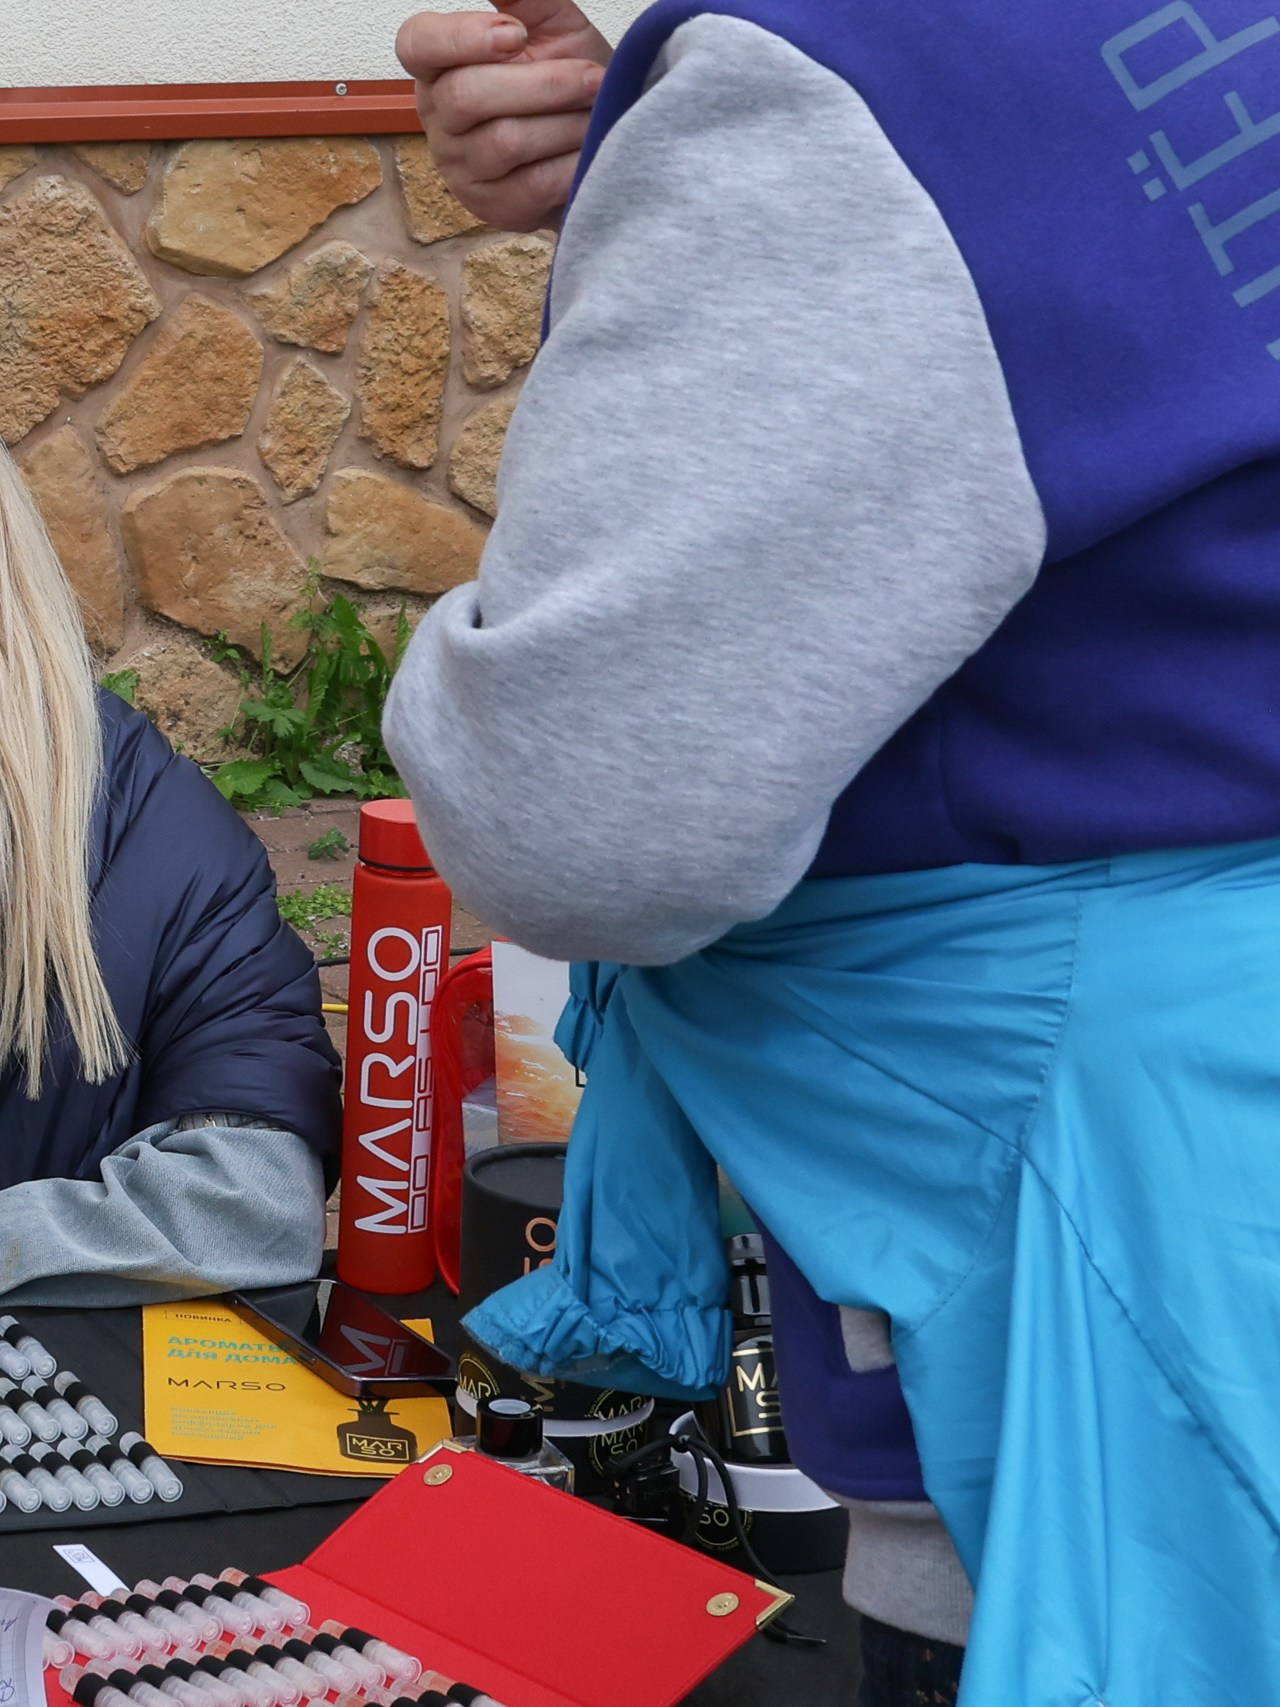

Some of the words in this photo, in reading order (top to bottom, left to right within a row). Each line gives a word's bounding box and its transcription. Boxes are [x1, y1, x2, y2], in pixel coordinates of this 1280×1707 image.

[1101, 0, 1280, 362] ТЁР
[354, 927, 421, 1234] MARSO
[410, 1154, 429, 1231] DO
[175, 1313, 232, 1323] НОВИНКА
[167, 1348, 217, 1361] ДЛЯ
[224, 1353, 297, 1365] ДОМА
[168, 1377, 286, 1392] MARSO
[736, 1362, 777, 1392] M
[352, 1437, 403, 1450] MAR
[361, 1446, 396, 1457] SO
